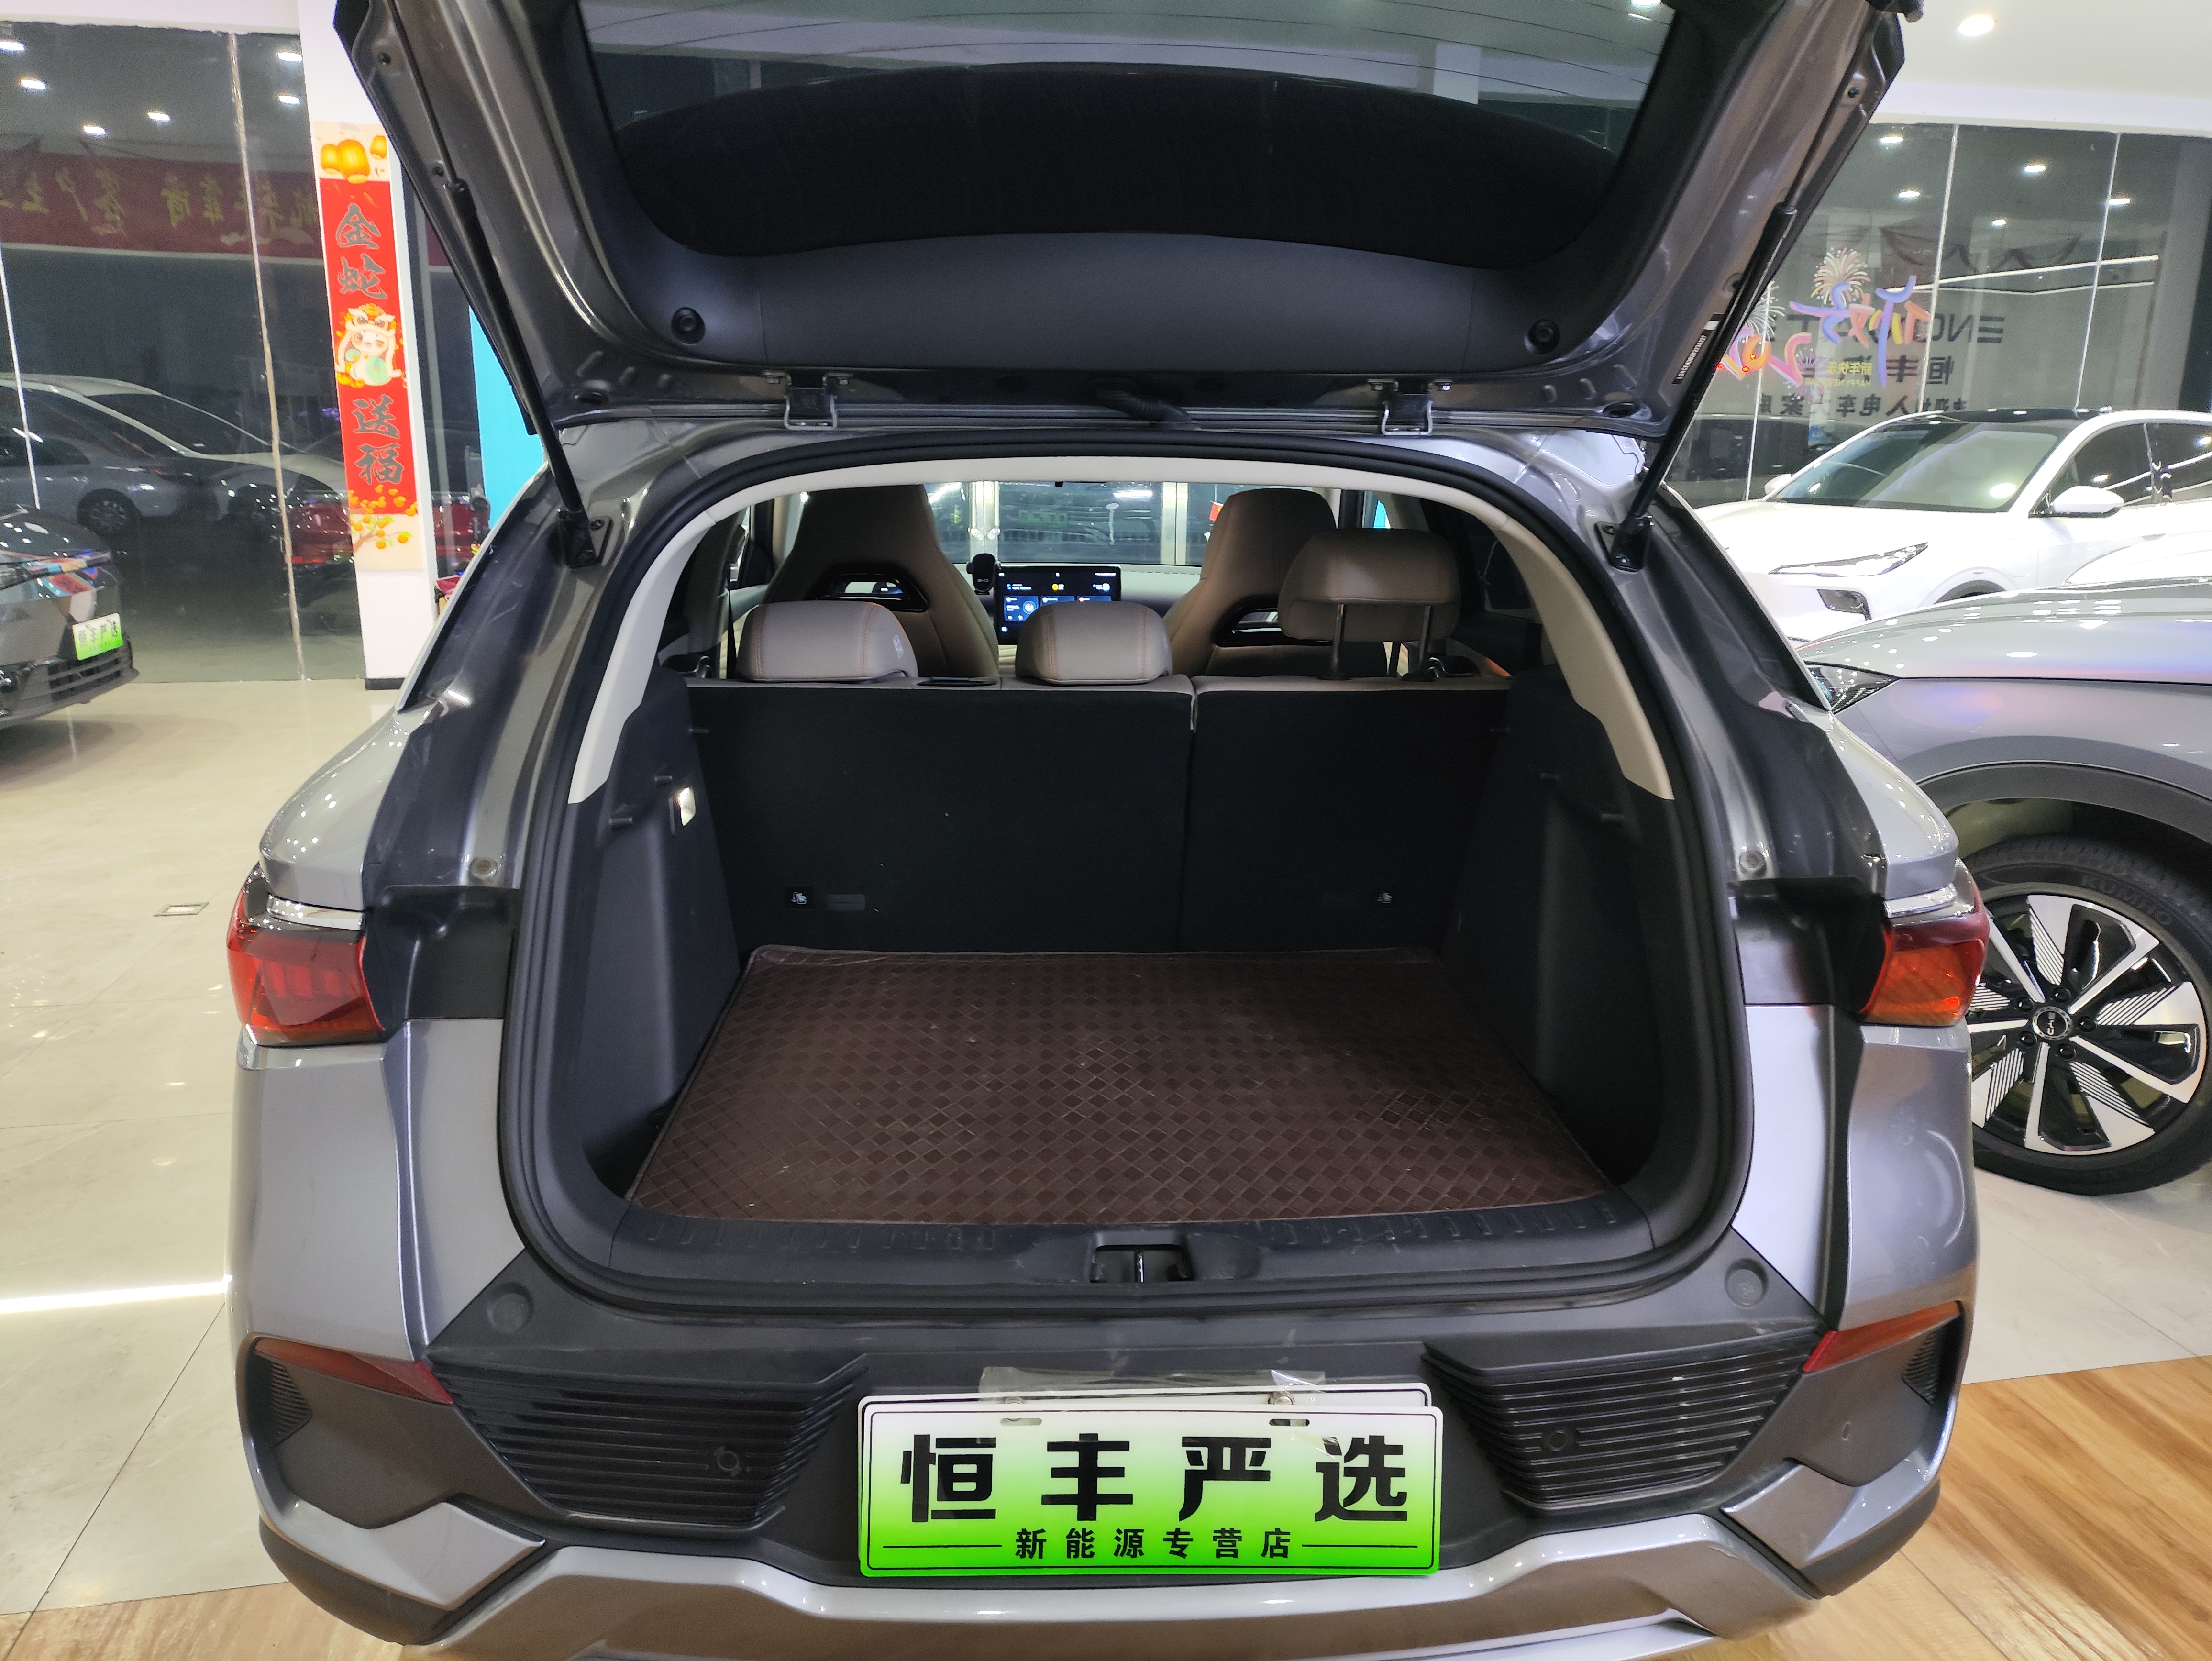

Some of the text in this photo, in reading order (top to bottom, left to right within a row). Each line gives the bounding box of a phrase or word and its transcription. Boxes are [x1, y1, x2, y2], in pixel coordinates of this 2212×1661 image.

[335, 202, 405, 486] 金蛇 送福
[900, 1433, 1408, 1523] 恒丰严选
[1015, 1528, 1291, 1560] 新能源专营店
